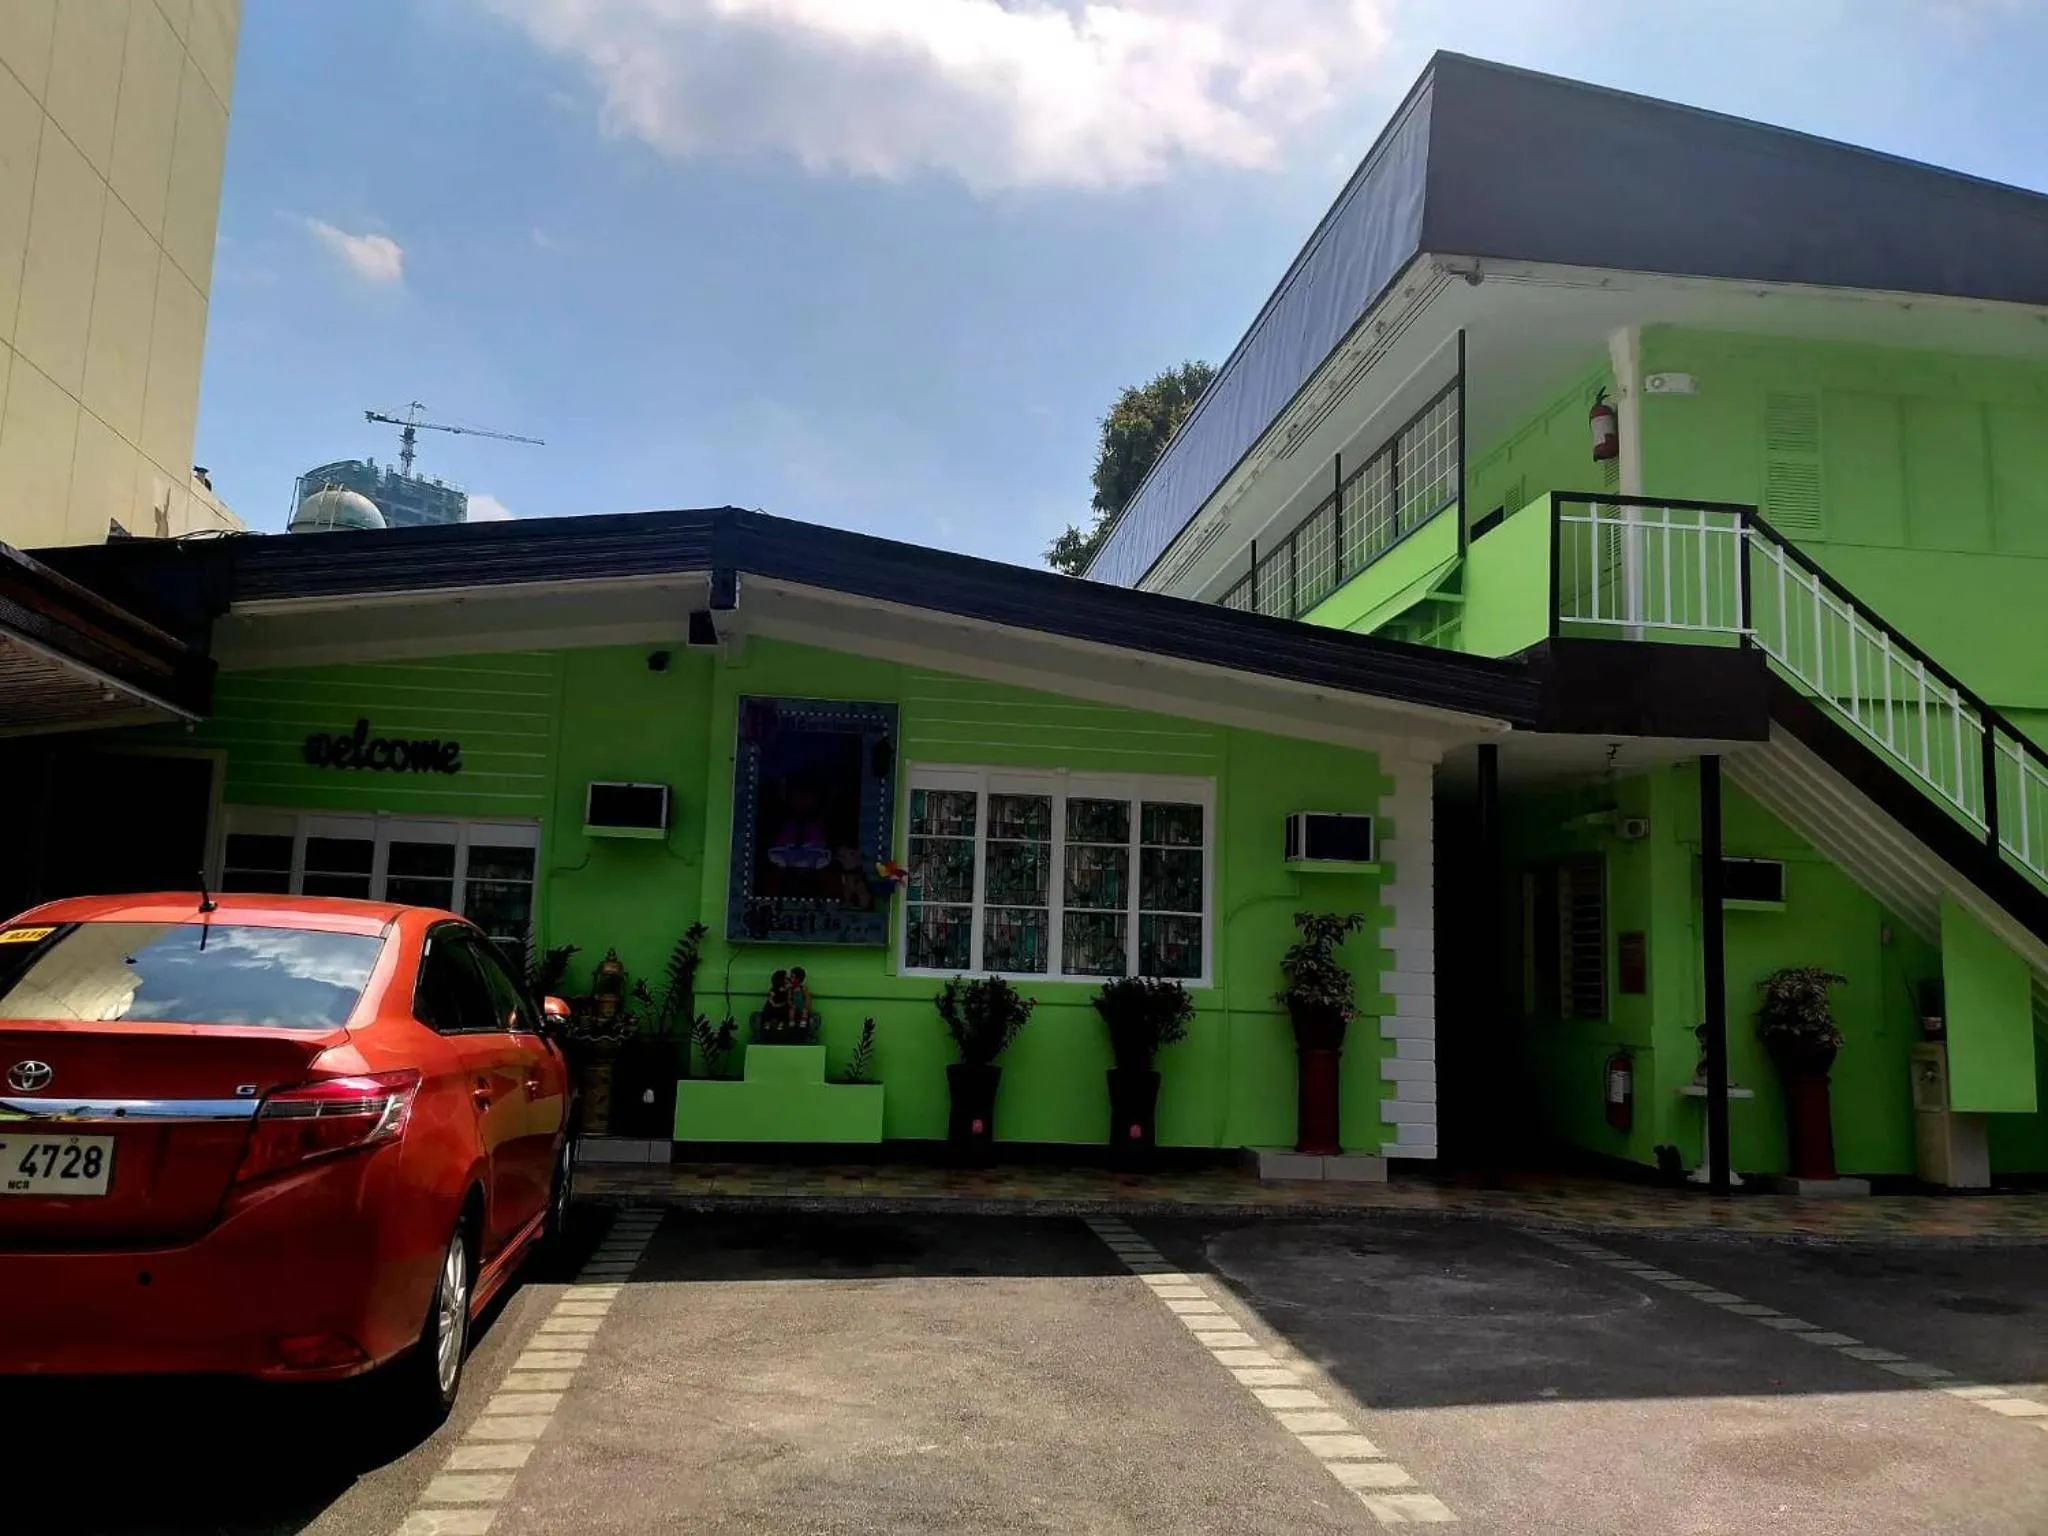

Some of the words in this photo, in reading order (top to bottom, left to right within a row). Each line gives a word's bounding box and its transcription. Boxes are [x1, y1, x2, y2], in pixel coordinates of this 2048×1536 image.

[302, 719, 462, 774] welcome
[236, 1084, 257, 1095] G
[18, 1144, 103, 1179] 4728
[8, 1180, 30, 1190] NCR
